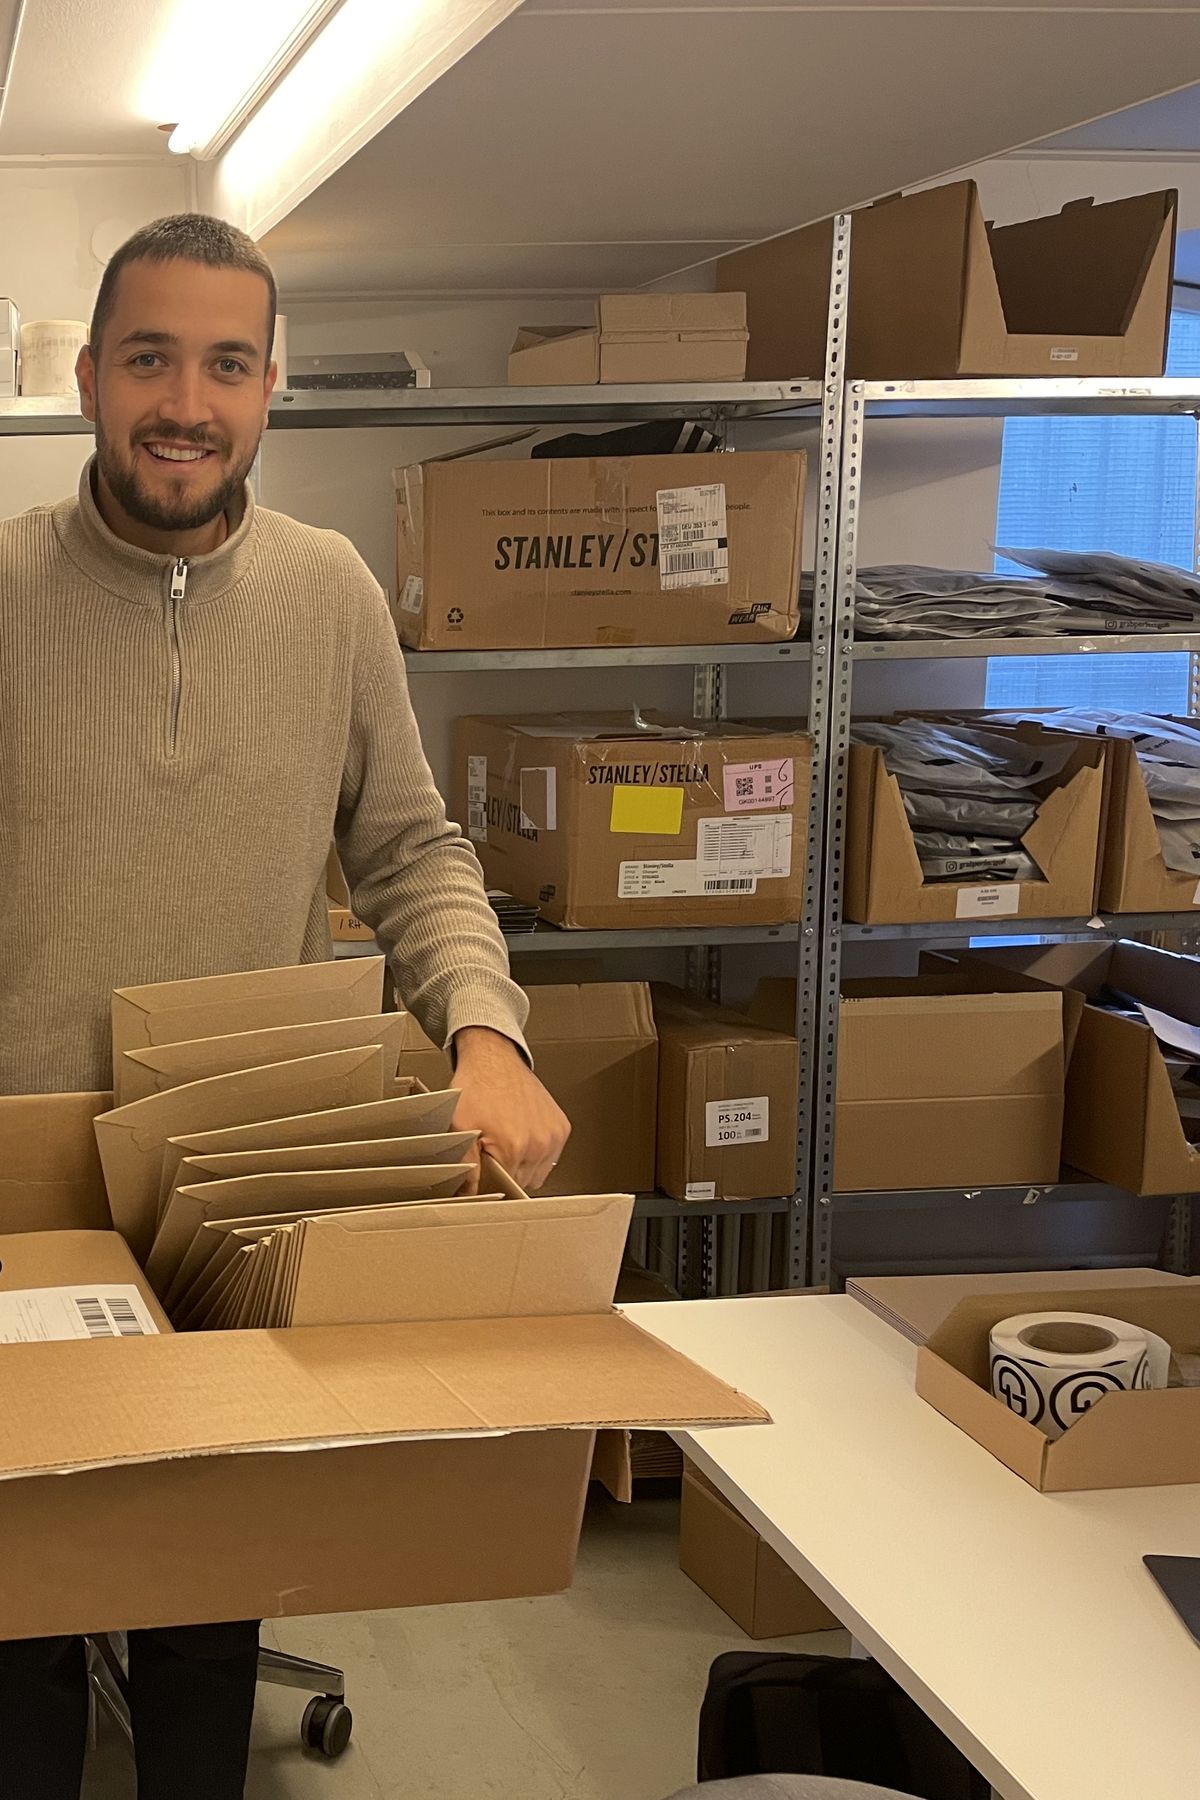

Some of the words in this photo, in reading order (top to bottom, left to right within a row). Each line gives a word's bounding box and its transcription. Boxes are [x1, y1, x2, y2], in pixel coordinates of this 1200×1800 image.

[512, 508, 525, 516] and
[494, 528, 660, 573] STANLEY/ST
[588, 761, 710, 786] STANLEY/STELLA
[718, 1130, 737, 1141] 100
